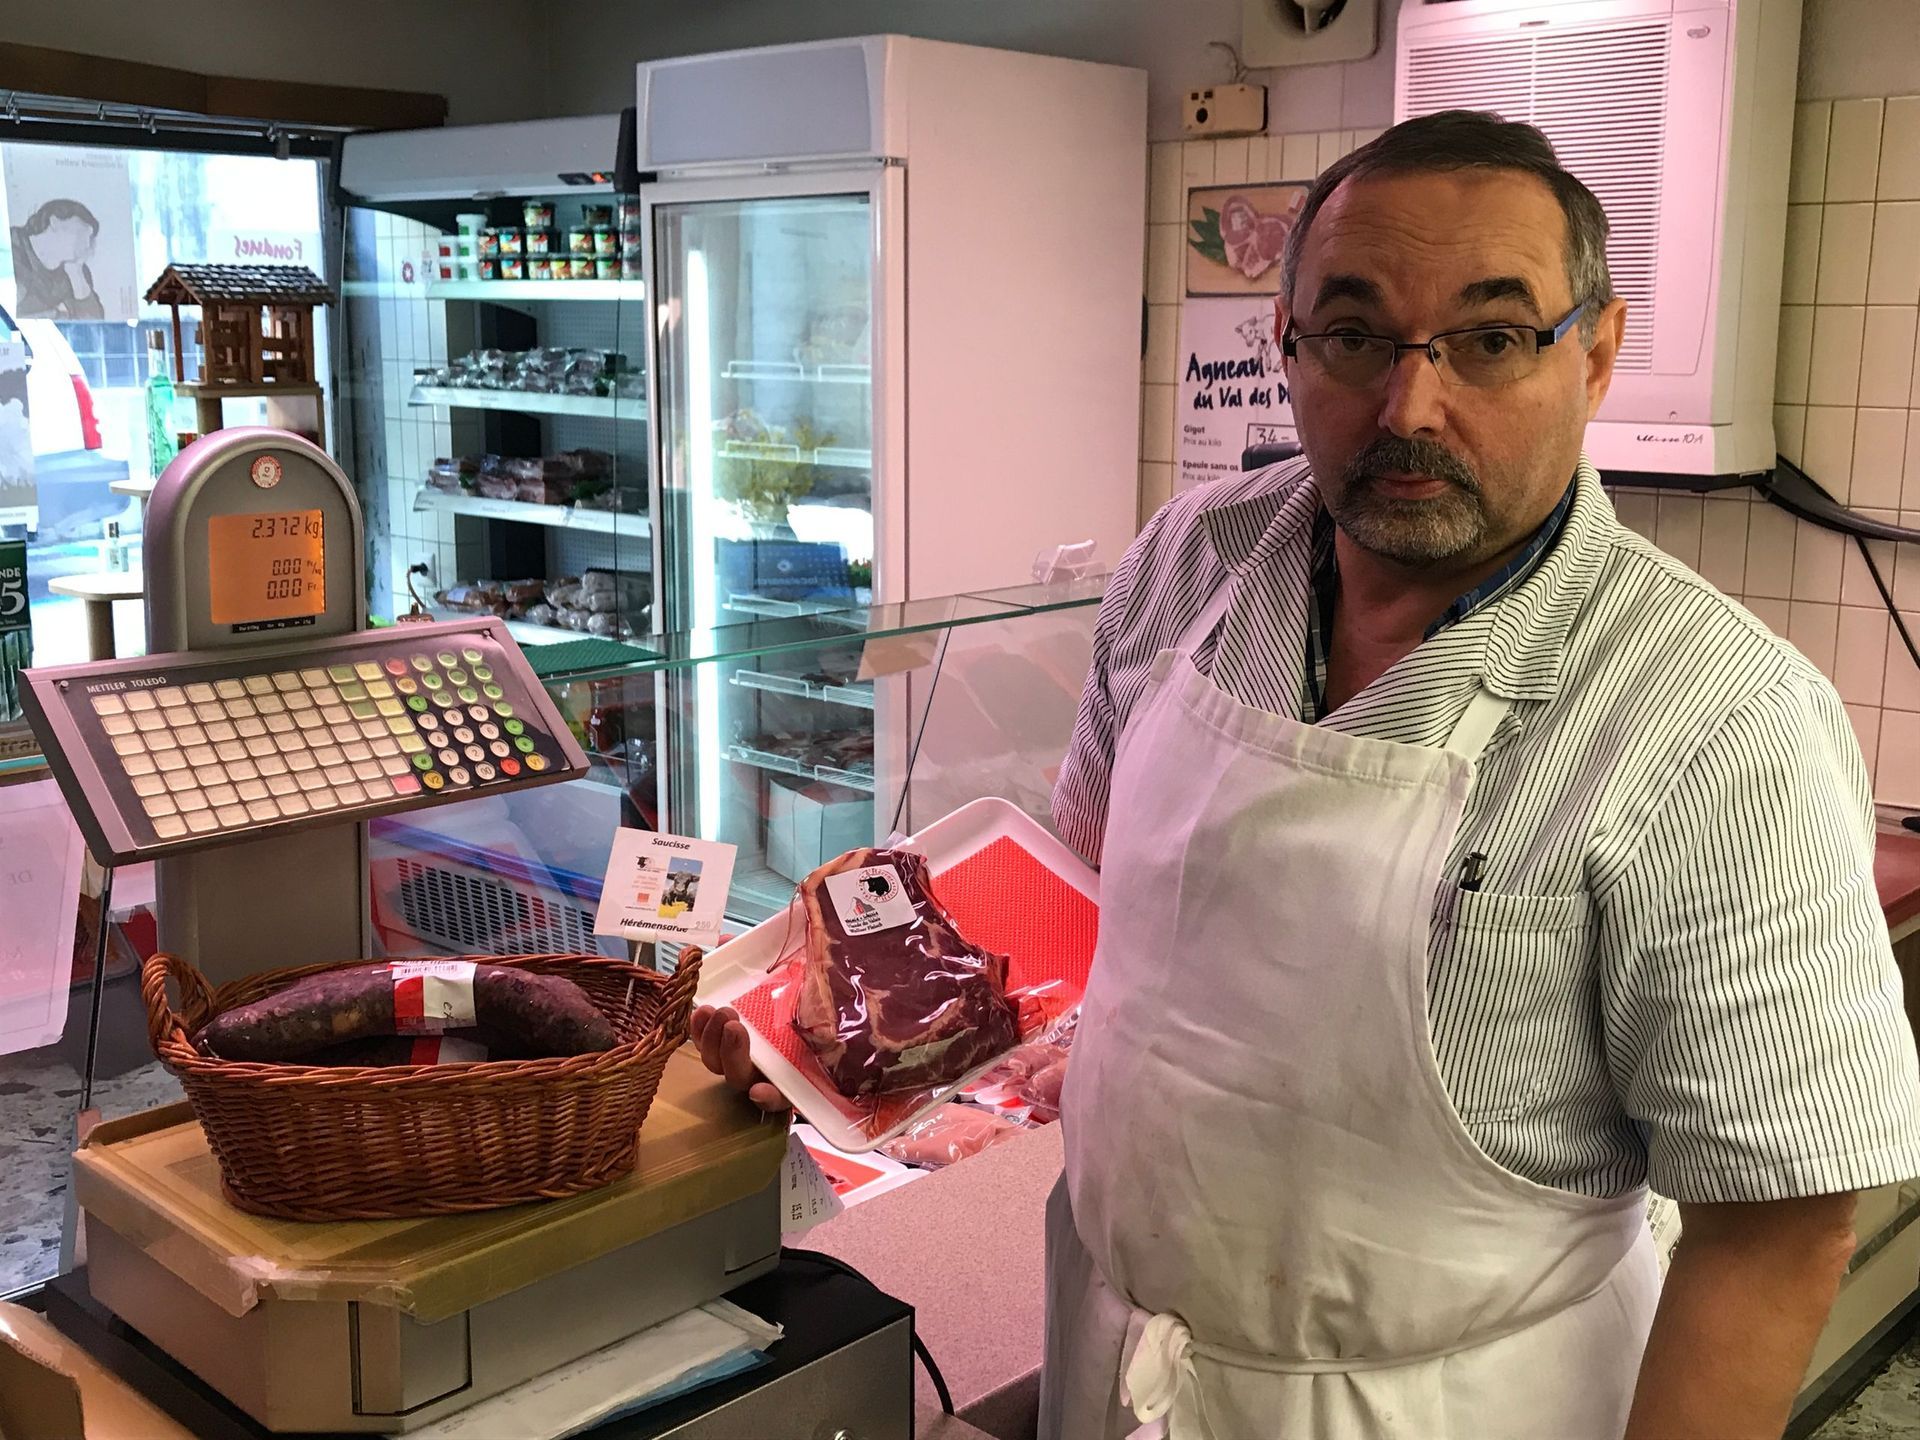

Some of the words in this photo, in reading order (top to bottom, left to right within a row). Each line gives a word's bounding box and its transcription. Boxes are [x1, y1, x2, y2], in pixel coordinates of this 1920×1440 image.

[1186, 352, 1265, 390] Agneau
[1193, 390, 1213, 410] du
[1219, 386, 1242, 408] Val
[1250, 387, 1271, 408] des
[1184, 424, 1205, 435] Gigot
[1183, 437, 1196, 445] Prix
[1208, 438, 1222, 446] kilo
[1183, 460, 1208, 471] Epaule
[1210, 462, 1227, 471] sans
[252, 517, 300, 538] 2.372
[304, 516, 319, 539] kg
[272, 558, 302, 576] 0.00
[0, 579, 25, 615] 5
[267, 578, 302, 600] 0.00
[86, 682, 127, 694] METTLER
[130, 676, 167, 688] TOLEDO
[652, 838, 691, 850] Saucisse
